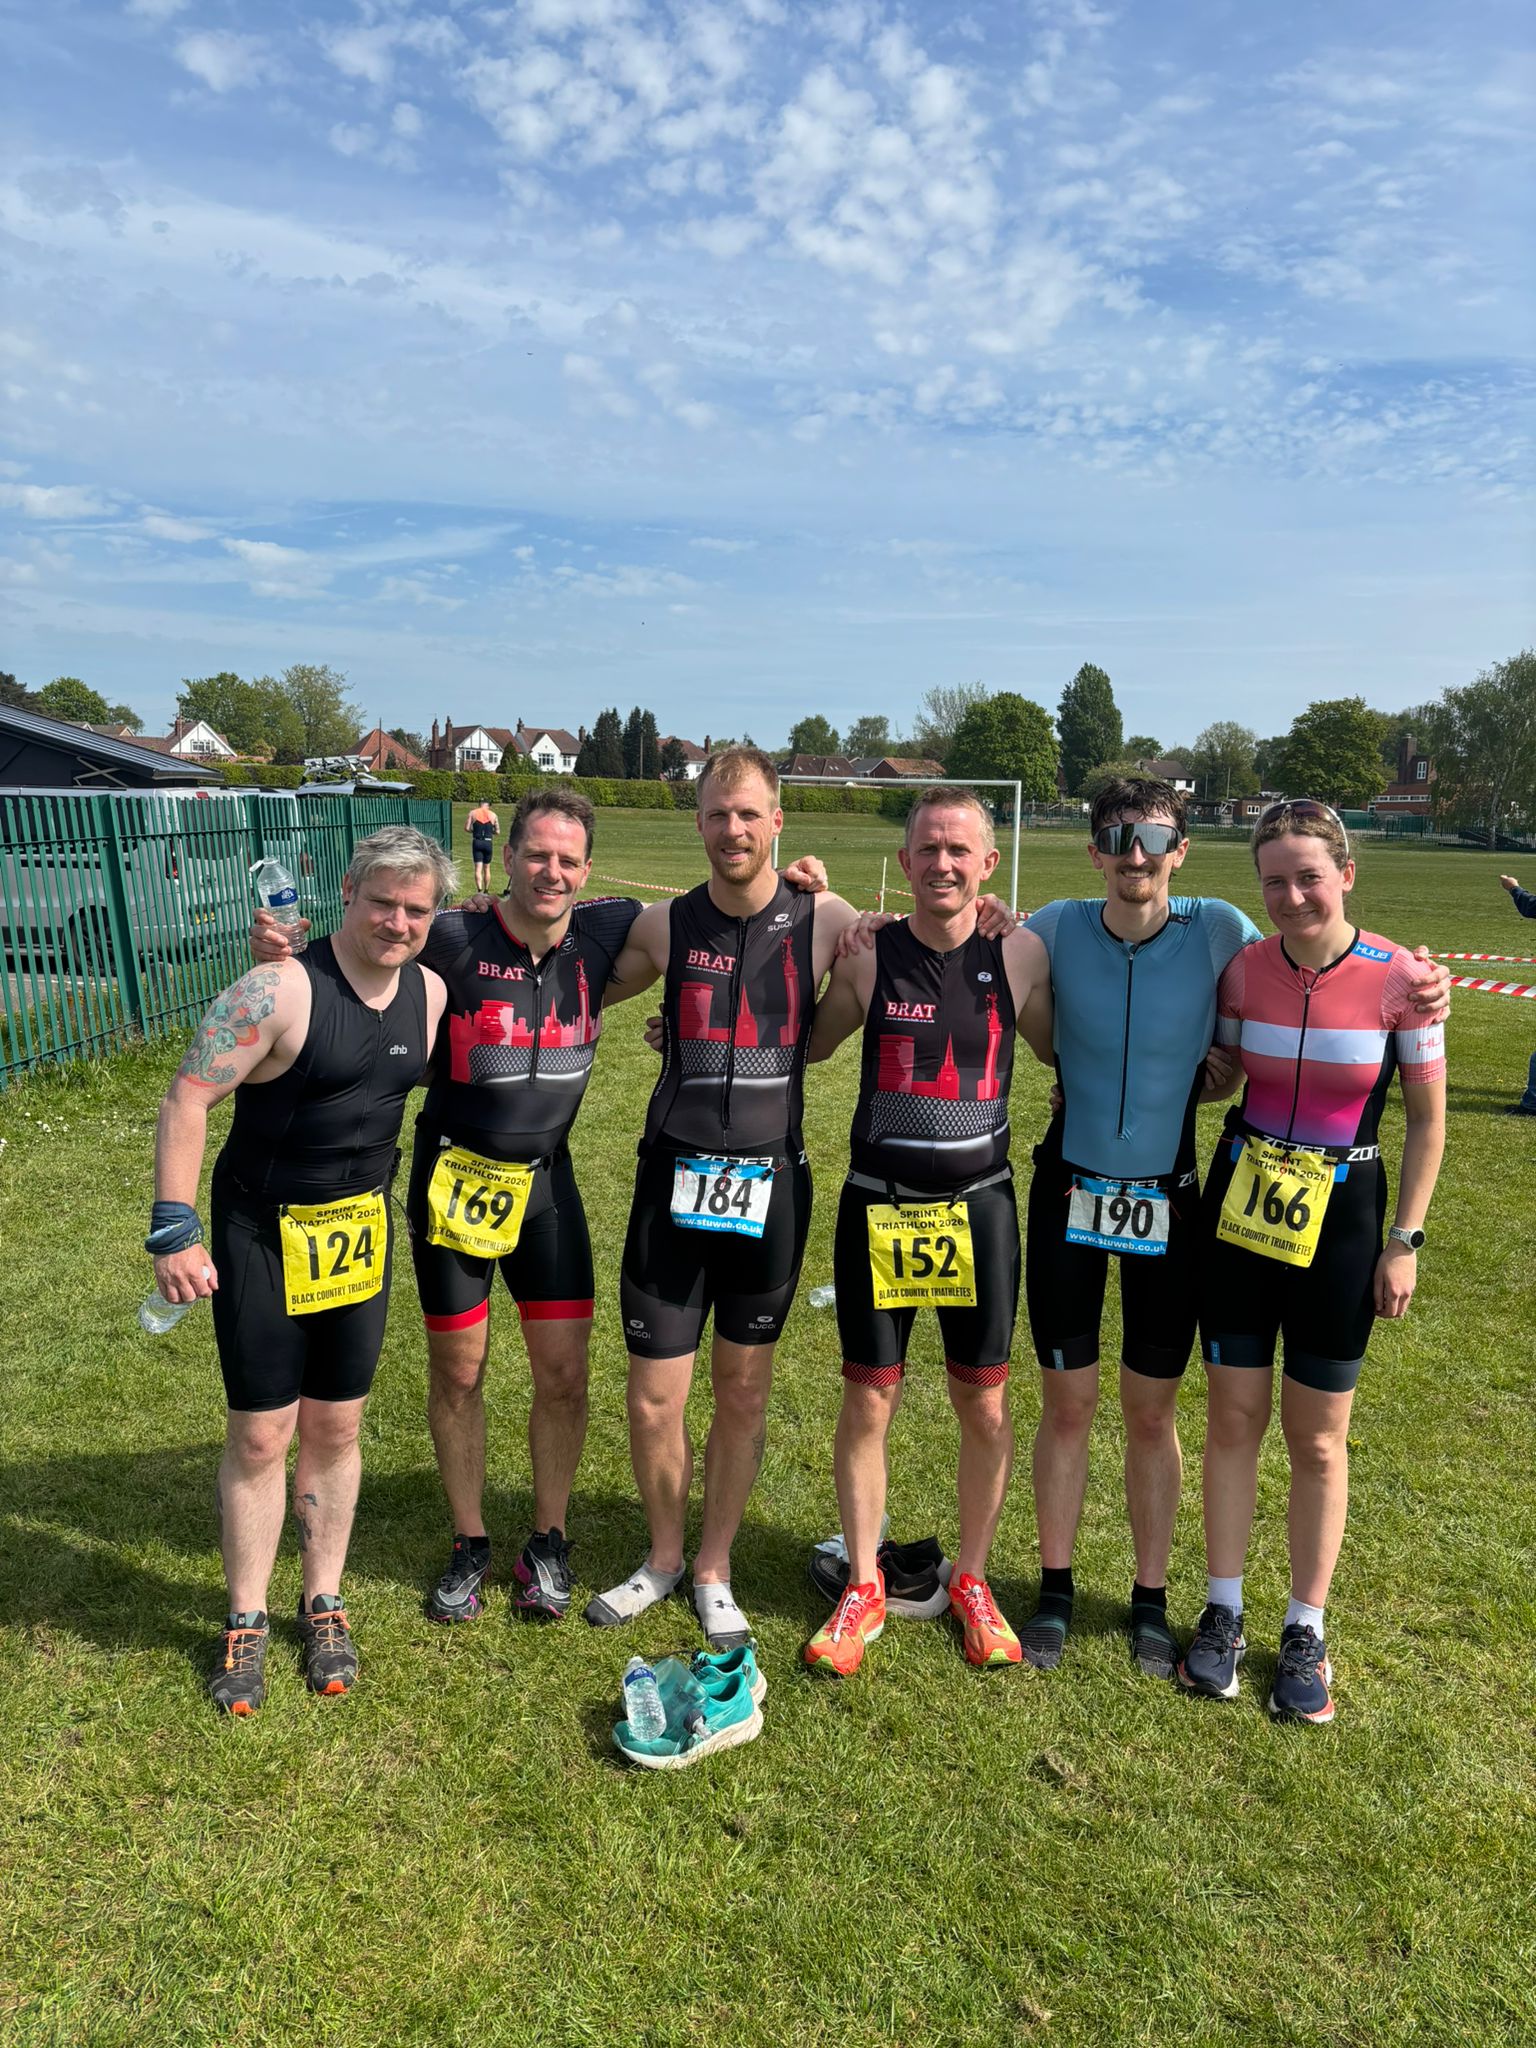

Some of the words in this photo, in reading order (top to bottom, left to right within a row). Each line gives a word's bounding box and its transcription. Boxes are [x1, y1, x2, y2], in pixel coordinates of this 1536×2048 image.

[686, 949, 736, 972] BRAT
[1356, 945, 1388, 959] HUUB
[478, 961, 525, 981] BRAT
[886, 1001, 936, 1018] BRAT
[390, 1044, 408, 1056] dhb
[444, 1159, 502, 1182] TRIATHLON
[504, 1176, 527, 1187] 2026
[1299, 1170, 1327, 1182] 2026
[447, 1178, 514, 1231] 169
[692, 1174, 752, 1218] 184
[1244, 1174, 1311, 1232] 166
[288, 1213, 353, 1229] TRIATHLON
[357, 1207, 381, 1219] 2026
[316, 1203, 357, 1218] SPRINT
[900, 1209, 938, 1219] SPRINT
[1093, 1195, 1154, 1239] 190
[674, 1216, 763, 1235] www.stuweb.co.uk
[875, 1220, 936, 1231] TRIATHLON
[939, 1218, 964, 1228] 2026
[446, 1229, 472, 1245] COUNTRY
[1221, 1219, 1241, 1234] BLACK
[1241, 1225, 1270, 1245] COUNTRY
[1271, 1236, 1312, 1257] TRIATHLETES
[308, 1225, 375, 1281] 124
[892, 1235, 958, 1279] 152
[291, 1293, 315, 1305] BLACK
[316, 1286, 346, 1301] COUNTRY
[879, 1288, 898, 1300] BLACK
[900, 1287, 929, 1298] COUNTRY
[931, 1287, 972, 1297] TRIATHLETES
